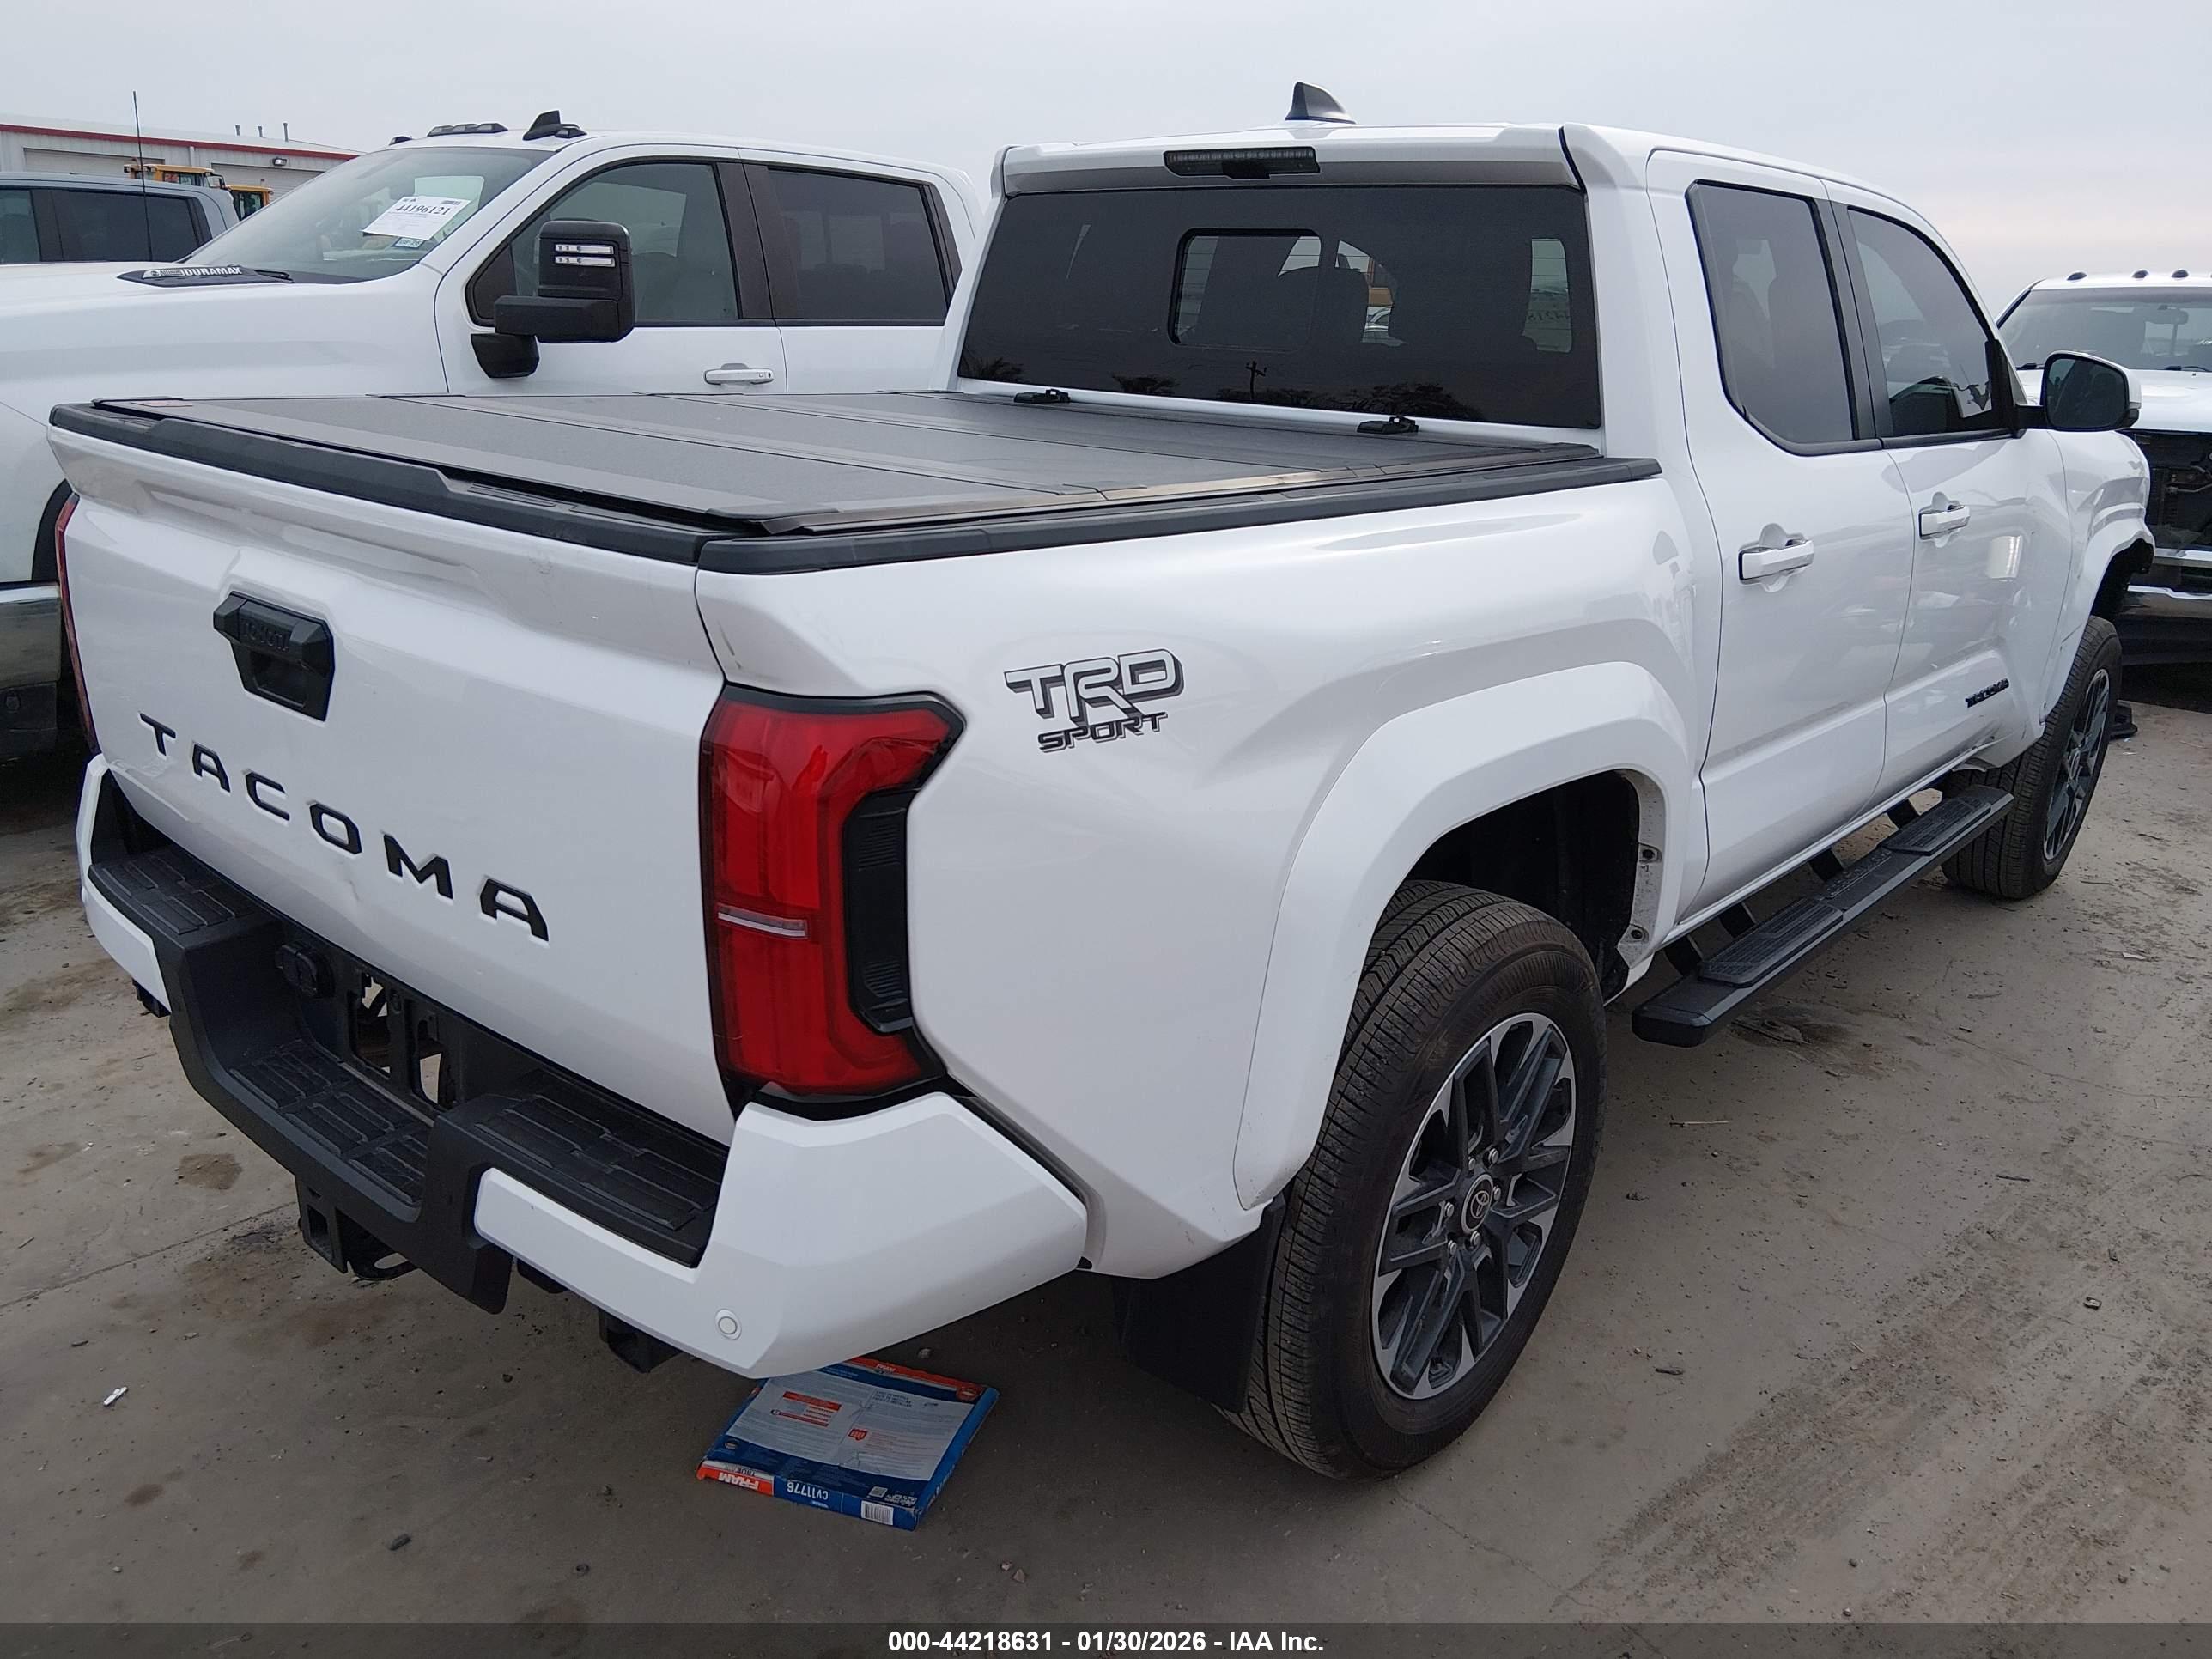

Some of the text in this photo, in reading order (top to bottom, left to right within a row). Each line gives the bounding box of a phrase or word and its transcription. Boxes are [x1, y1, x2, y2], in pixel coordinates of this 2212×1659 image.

[396, 204, 451, 215] 44196121
[182, 267, 242, 276] DURAMAX
[1004, 648, 1184, 726] TRD
[1037, 712, 1168, 753] SPORT
[138, 711, 550, 943] TACOMA
[718, 1472, 760, 1491] FRAM
[787, 1481, 830, 1500] CV11776
